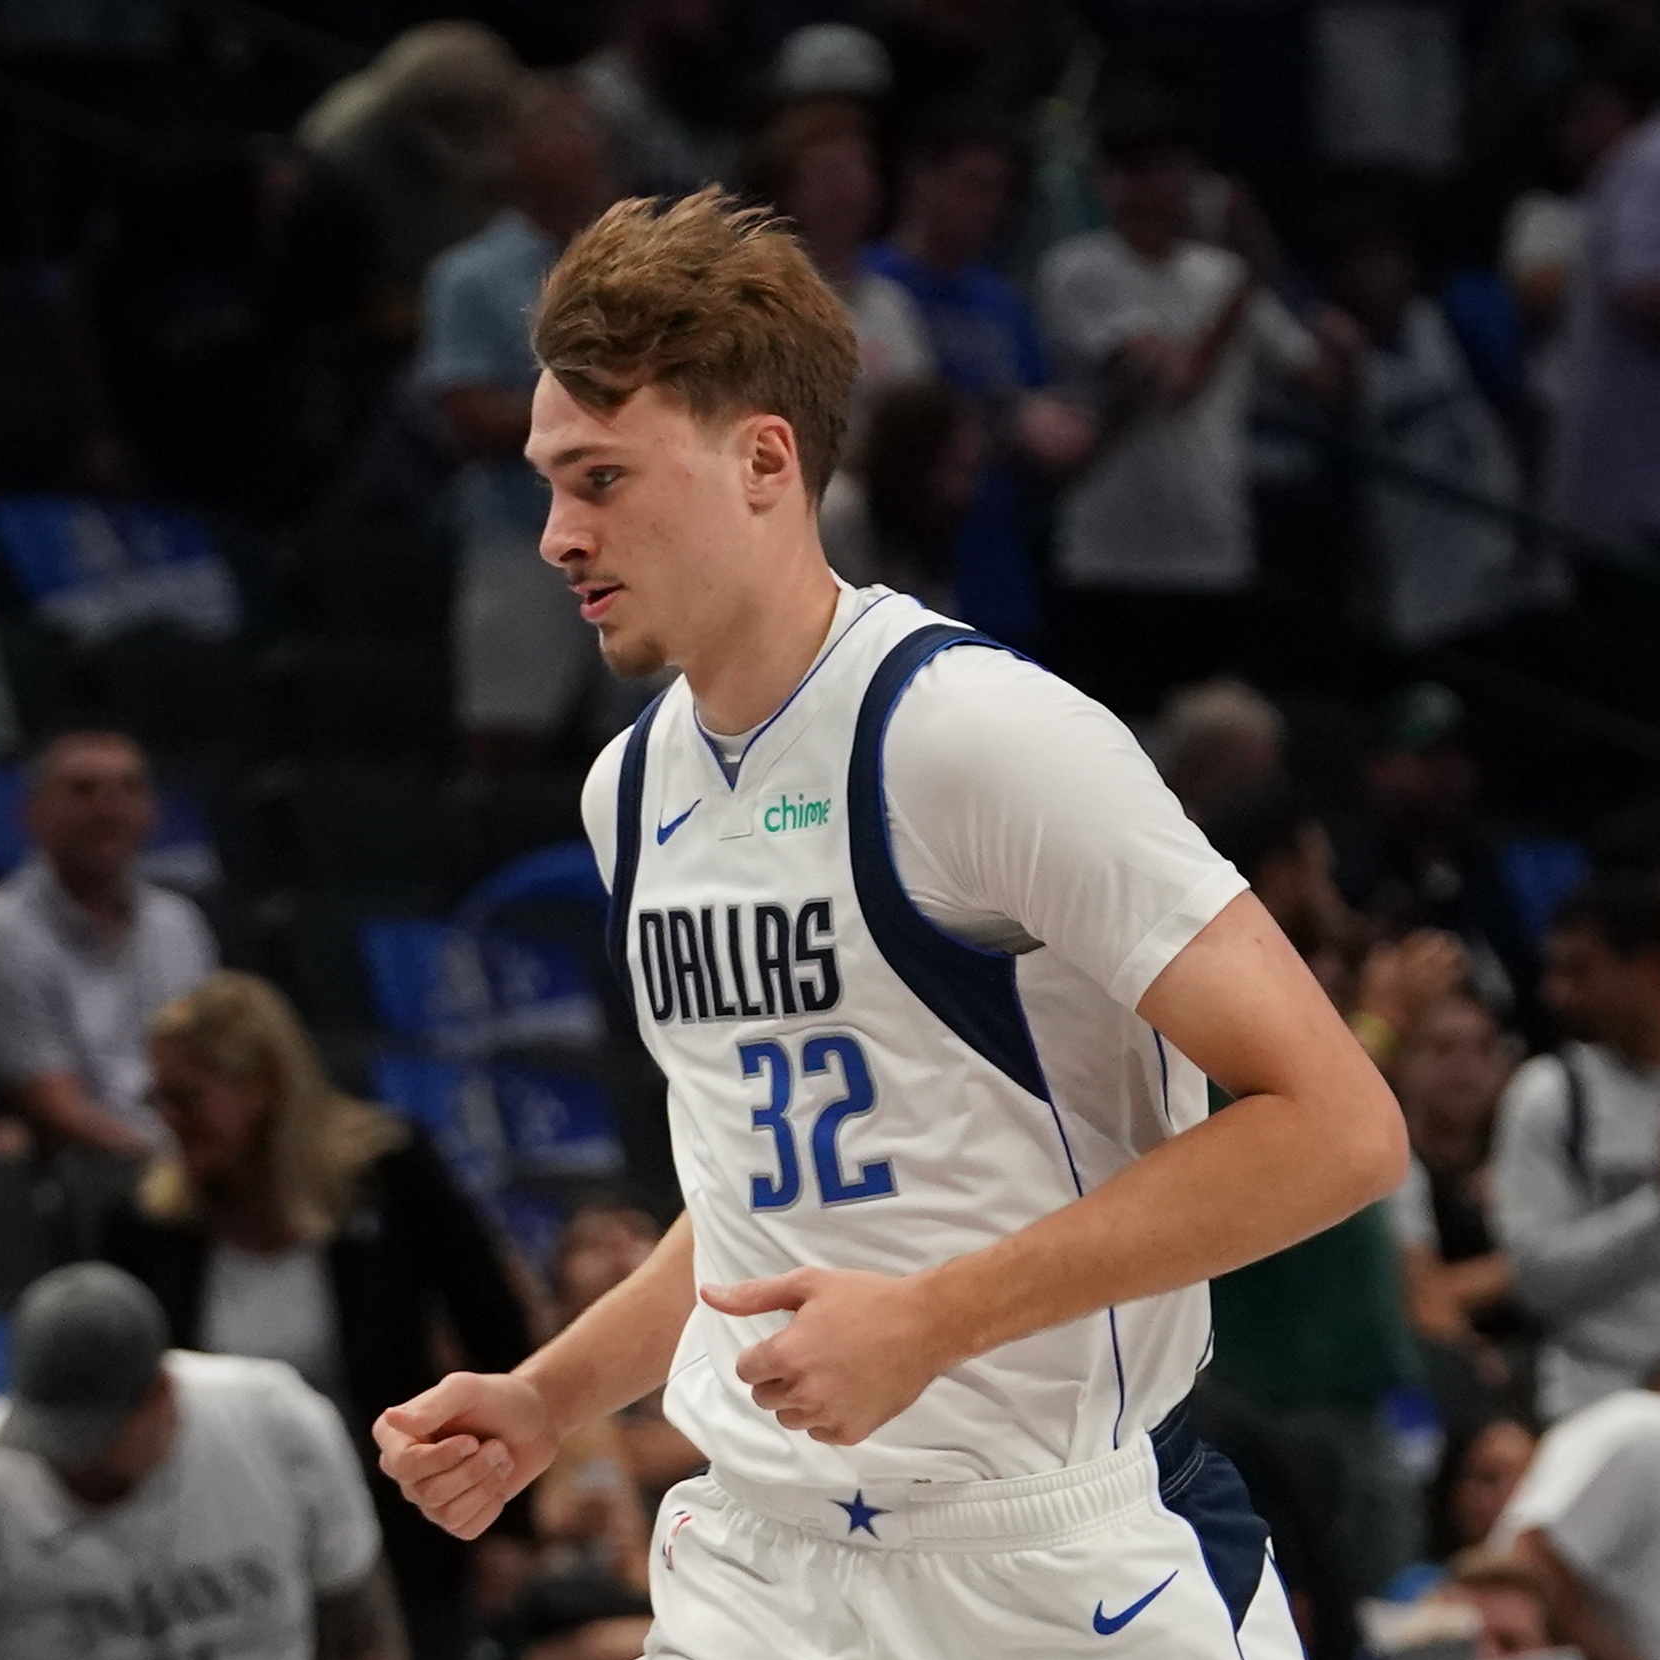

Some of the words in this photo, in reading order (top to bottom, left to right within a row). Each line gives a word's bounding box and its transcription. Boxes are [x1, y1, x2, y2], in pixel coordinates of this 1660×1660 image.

[764, 793, 831, 833] chime
[639, 897, 844, 1026] DALLAS
[736, 1031, 899, 1214] 32
